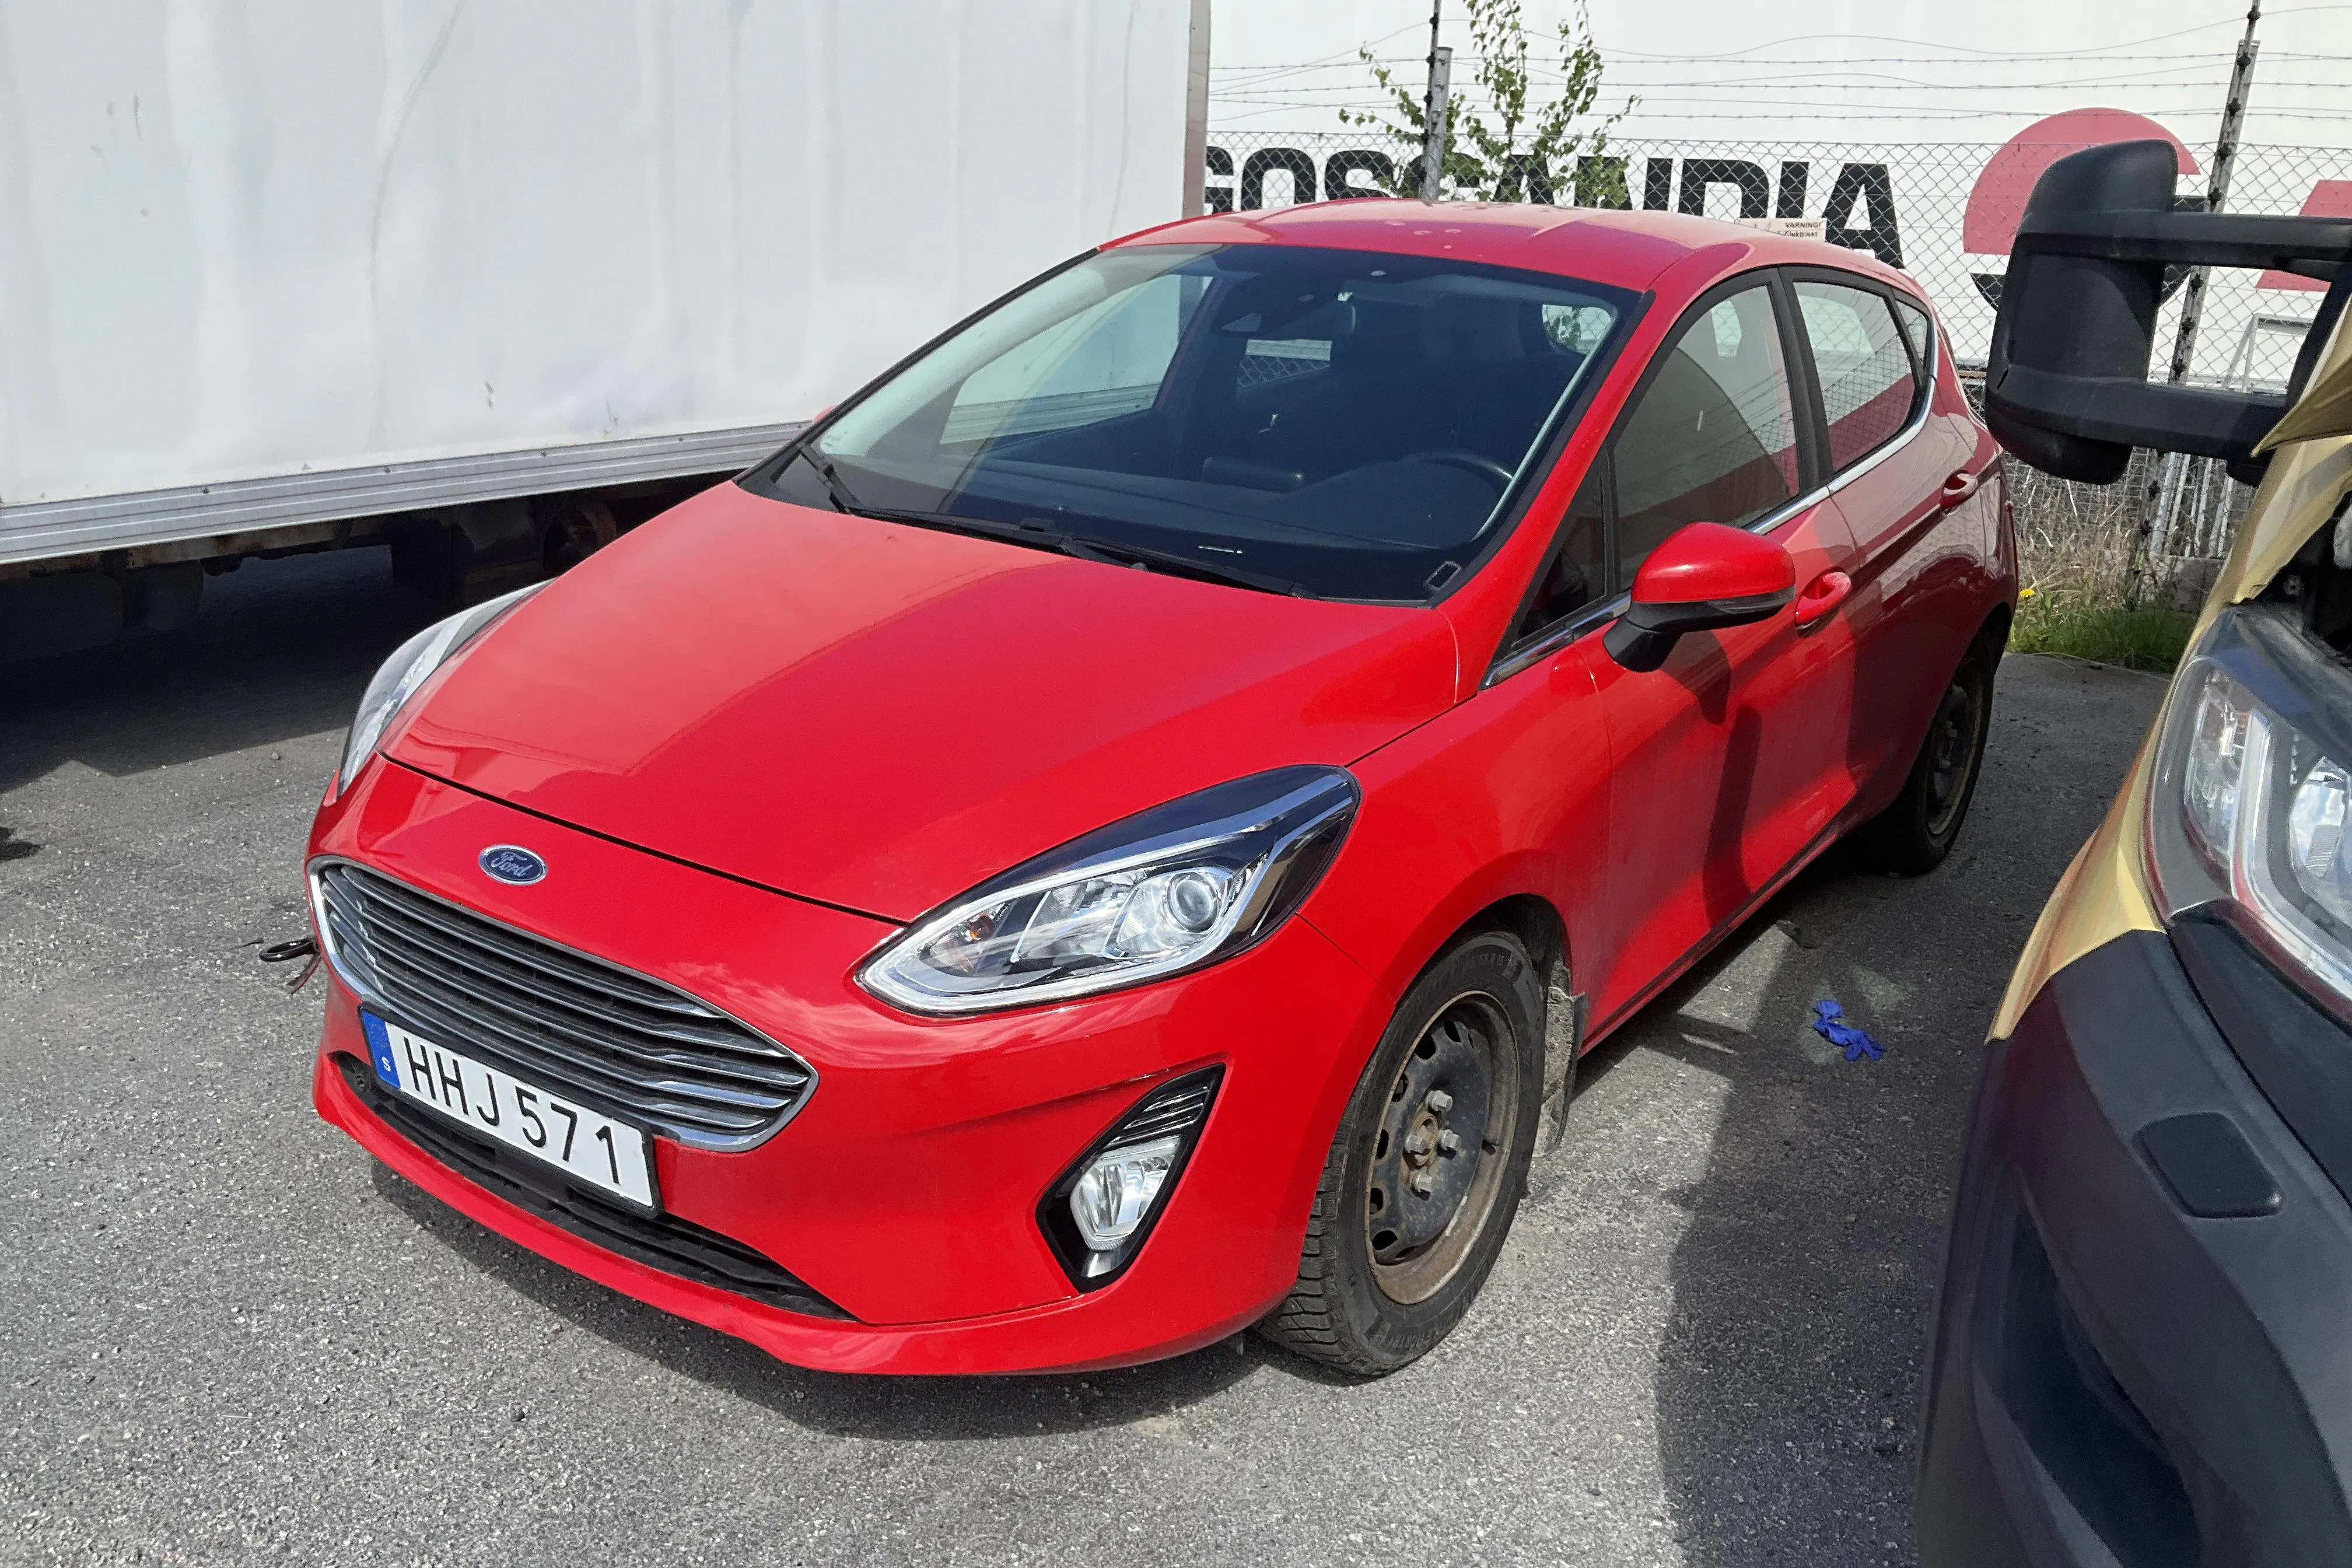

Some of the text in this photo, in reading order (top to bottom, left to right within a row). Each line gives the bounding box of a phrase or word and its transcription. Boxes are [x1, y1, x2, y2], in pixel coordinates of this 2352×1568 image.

[1205, 146, 1905, 269] OSANDIA
[491, 851, 533, 877] Ford
[382, 1056, 391, 1072] S
[404, 1037, 620, 1185] HHJ 571
